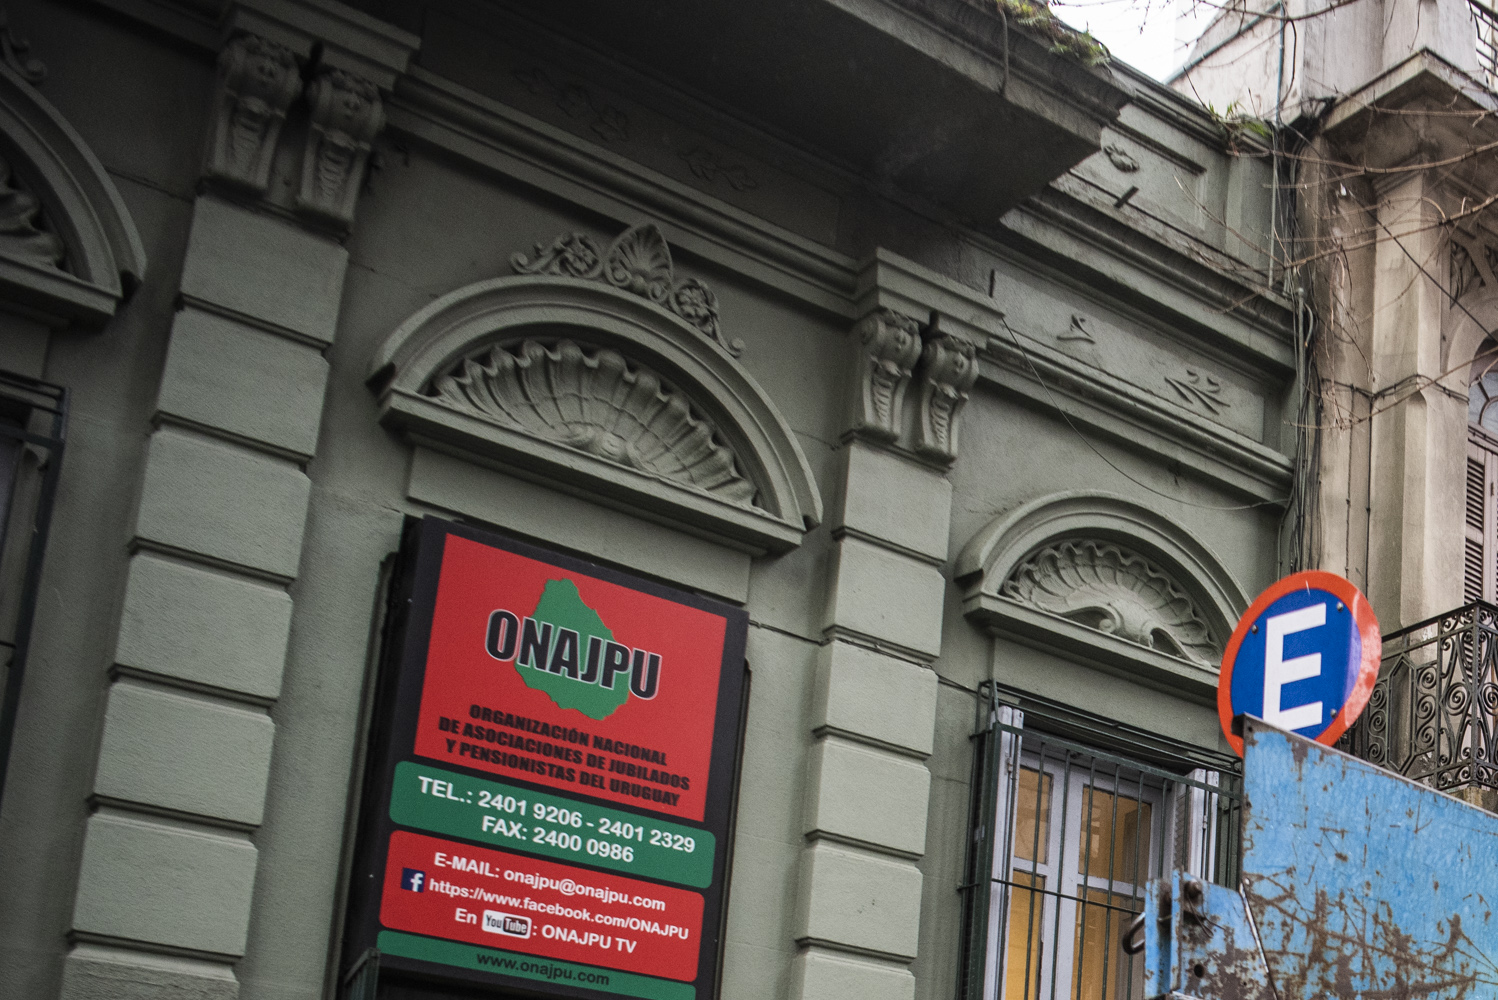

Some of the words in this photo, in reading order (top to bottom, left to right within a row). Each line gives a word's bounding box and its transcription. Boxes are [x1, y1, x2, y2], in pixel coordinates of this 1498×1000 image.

[486, 609, 662, 700] ONAJPU
[1262, 602, 1326, 731] E
[438, 716, 460, 734] DE
[463, 722, 582, 764] ASOCIACIONES
[586, 750, 606, 770] DE
[608, 757, 691, 791] JUBILADOS
[469, 704, 589, 747] ORGANIZACIÓN
[592, 734, 667, 766] NACIONAL
[445, 738, 457, 754] Y
[460, 743, 576, 782] PENSIONISTAS
[579, 768, 607, 790] DEL
[609, 777, 681, 807] URUGUAY
[417, 775, 473, 804] TEL.:
[477, 790, 528, 816] 2401
[533, 802, 583, 828] 9206
[597, 817, 645, 842] 2401
[649, 828, 696, 853] 2329
[481, 815, 527, 840] FAX:
[532, 826, 583, 851] 2400
[585, 837, 634, 863] 0986
[428, 877, 690, 940] https://www.facebook.com/ONAJPU
[433, 852, 500, 878] E-MAIL:
[503, 867, 667, 912] onajpu@onajpu.com
[454, 907, 478, 925] En
[541, 923, 612, 950] ONAJPU
[615, 936, 638, 954] TV
[476, 951, 611, 986] www.onajpu.com
